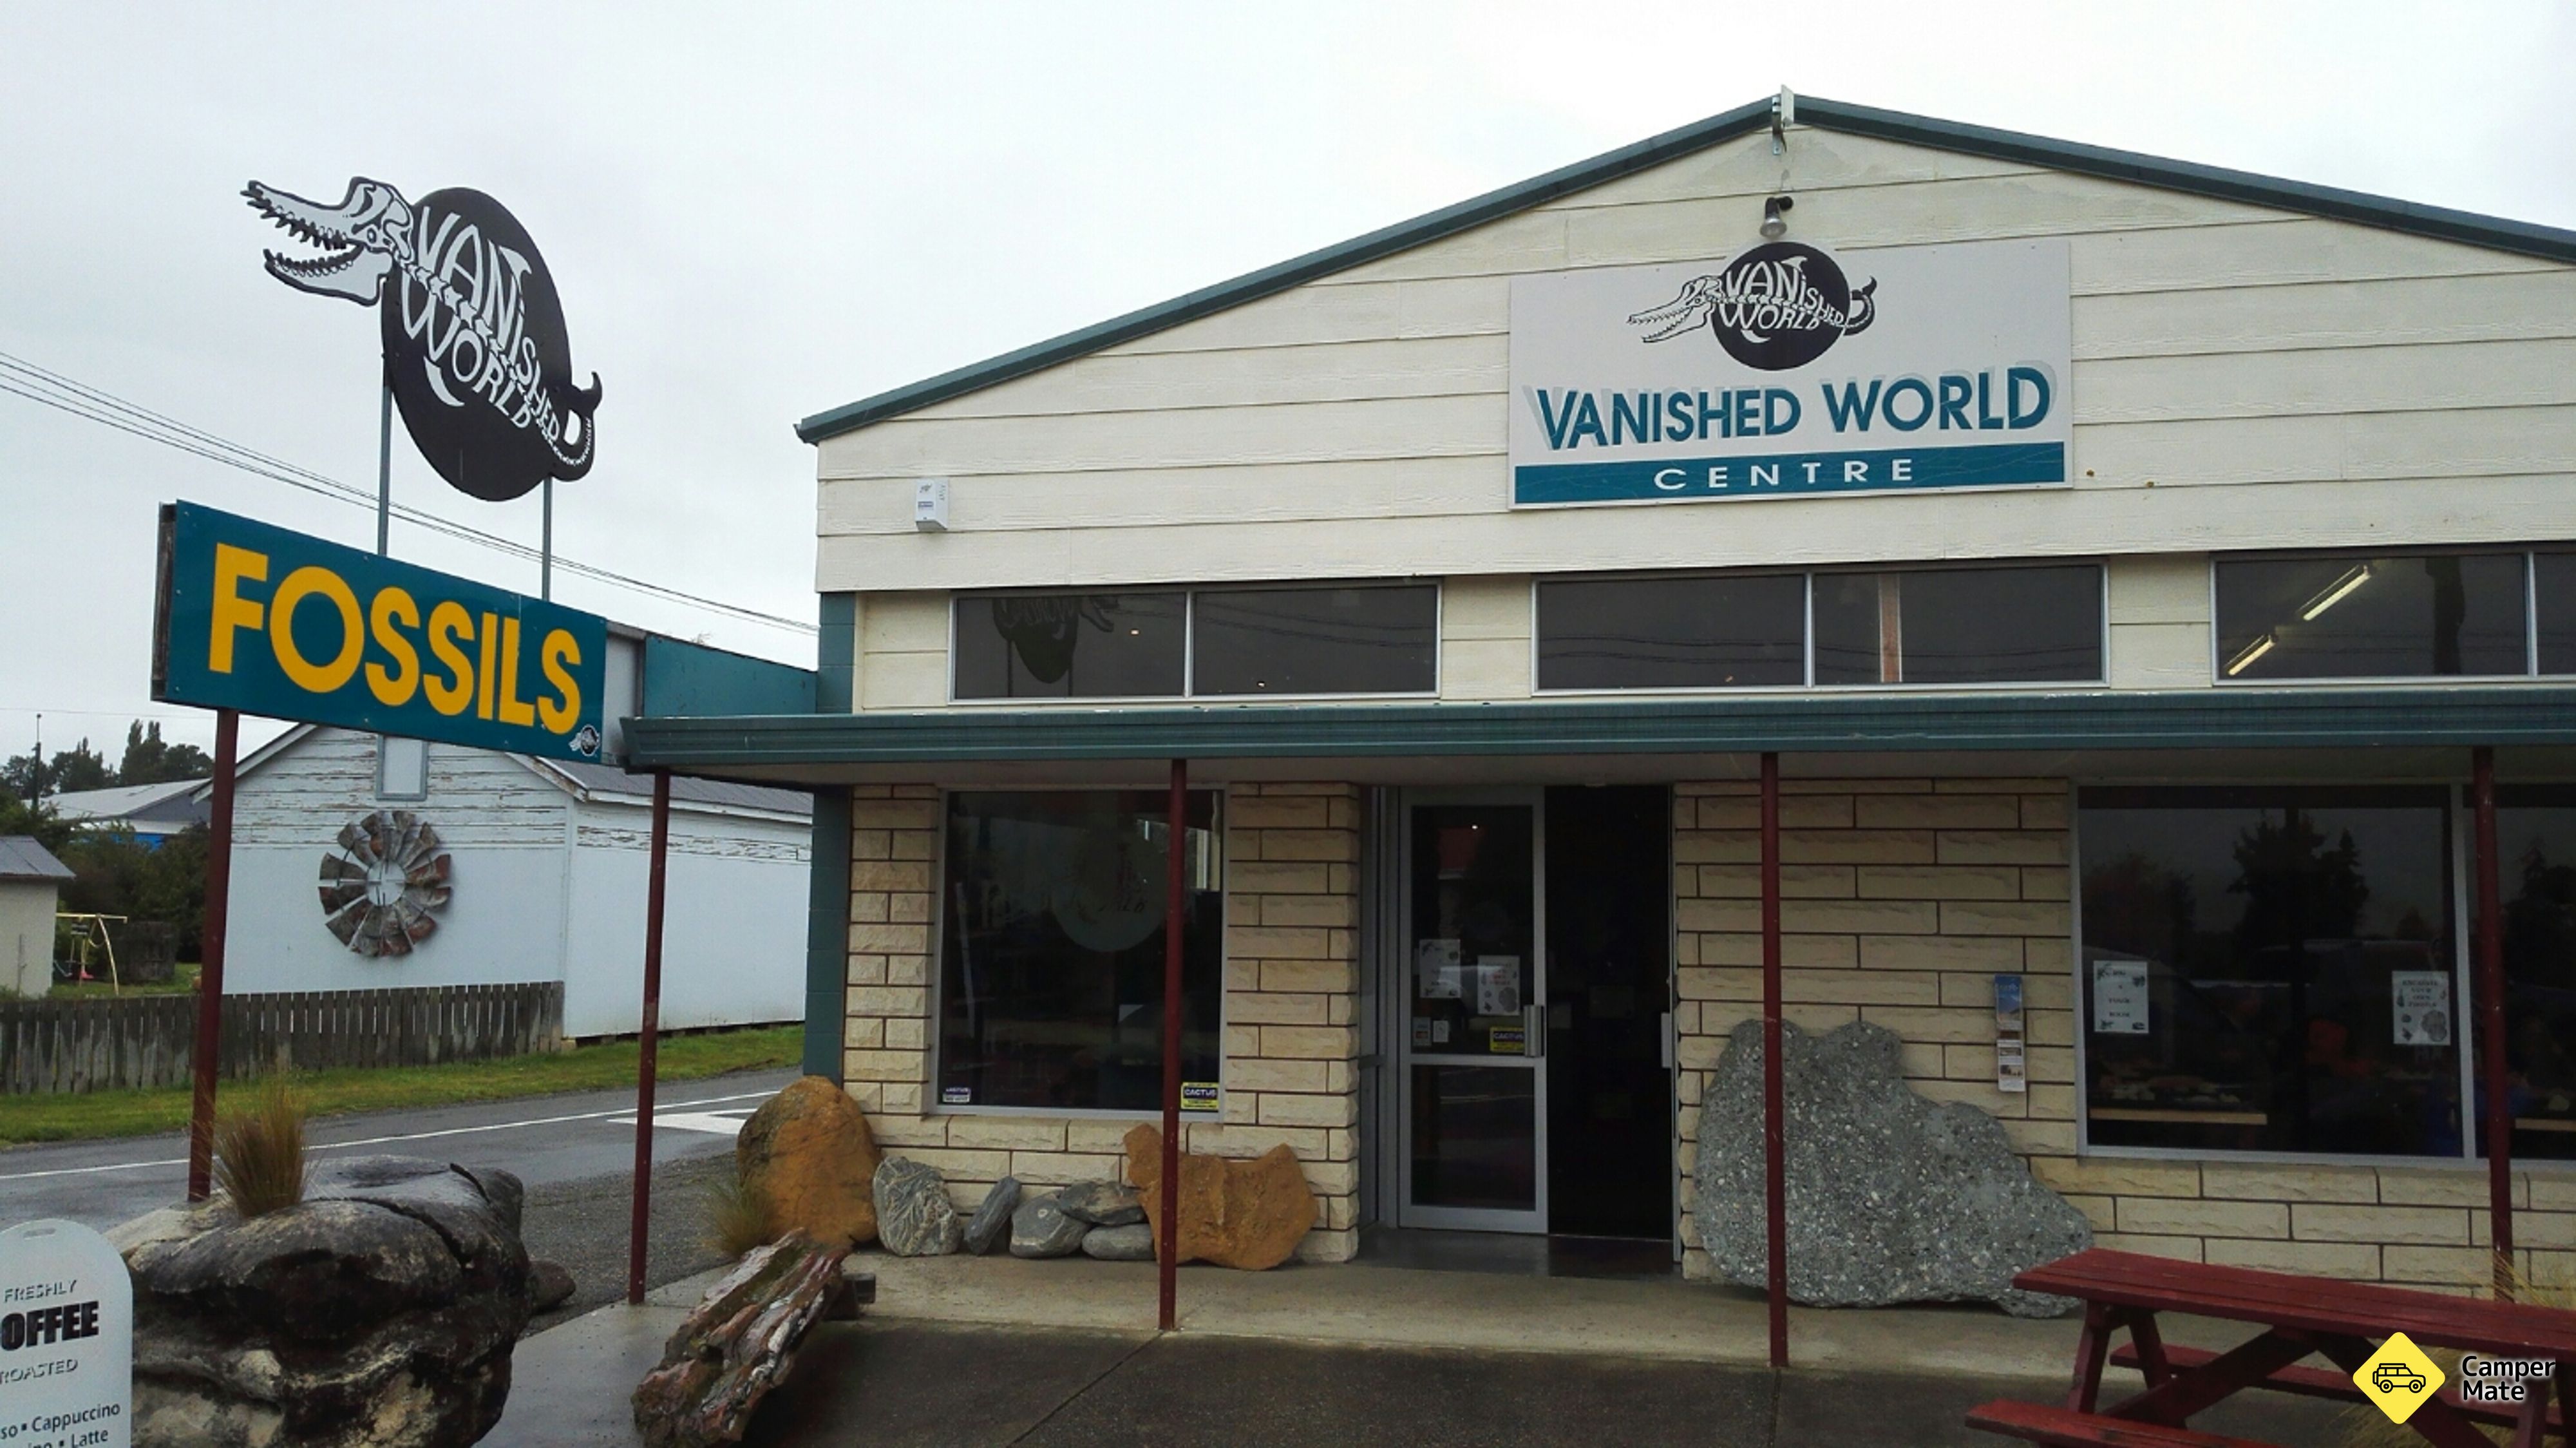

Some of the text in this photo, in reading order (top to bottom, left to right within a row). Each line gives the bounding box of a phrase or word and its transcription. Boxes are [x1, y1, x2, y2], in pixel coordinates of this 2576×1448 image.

[1719, 303, 1820, 330] WORLD
[400, 267, 531, 429] WORLD
[1535, 366, 2052, 451] VANISHED WORLD
[1653, 458, 1913, 491] CENTRE
[208, 542, 582, 735] FOSSILS
[1184, 1088, 1217, 1097] CACTUS
[5, 1279, 77, 1303] FRESHLY
[0, 1300, 99, 1351] OFFEE
[0, 1358, 79, 1385] ROASTED
[32, 1403, 120, 1433] Cappuccino
[71, 1429, 109, 1448] Latte
